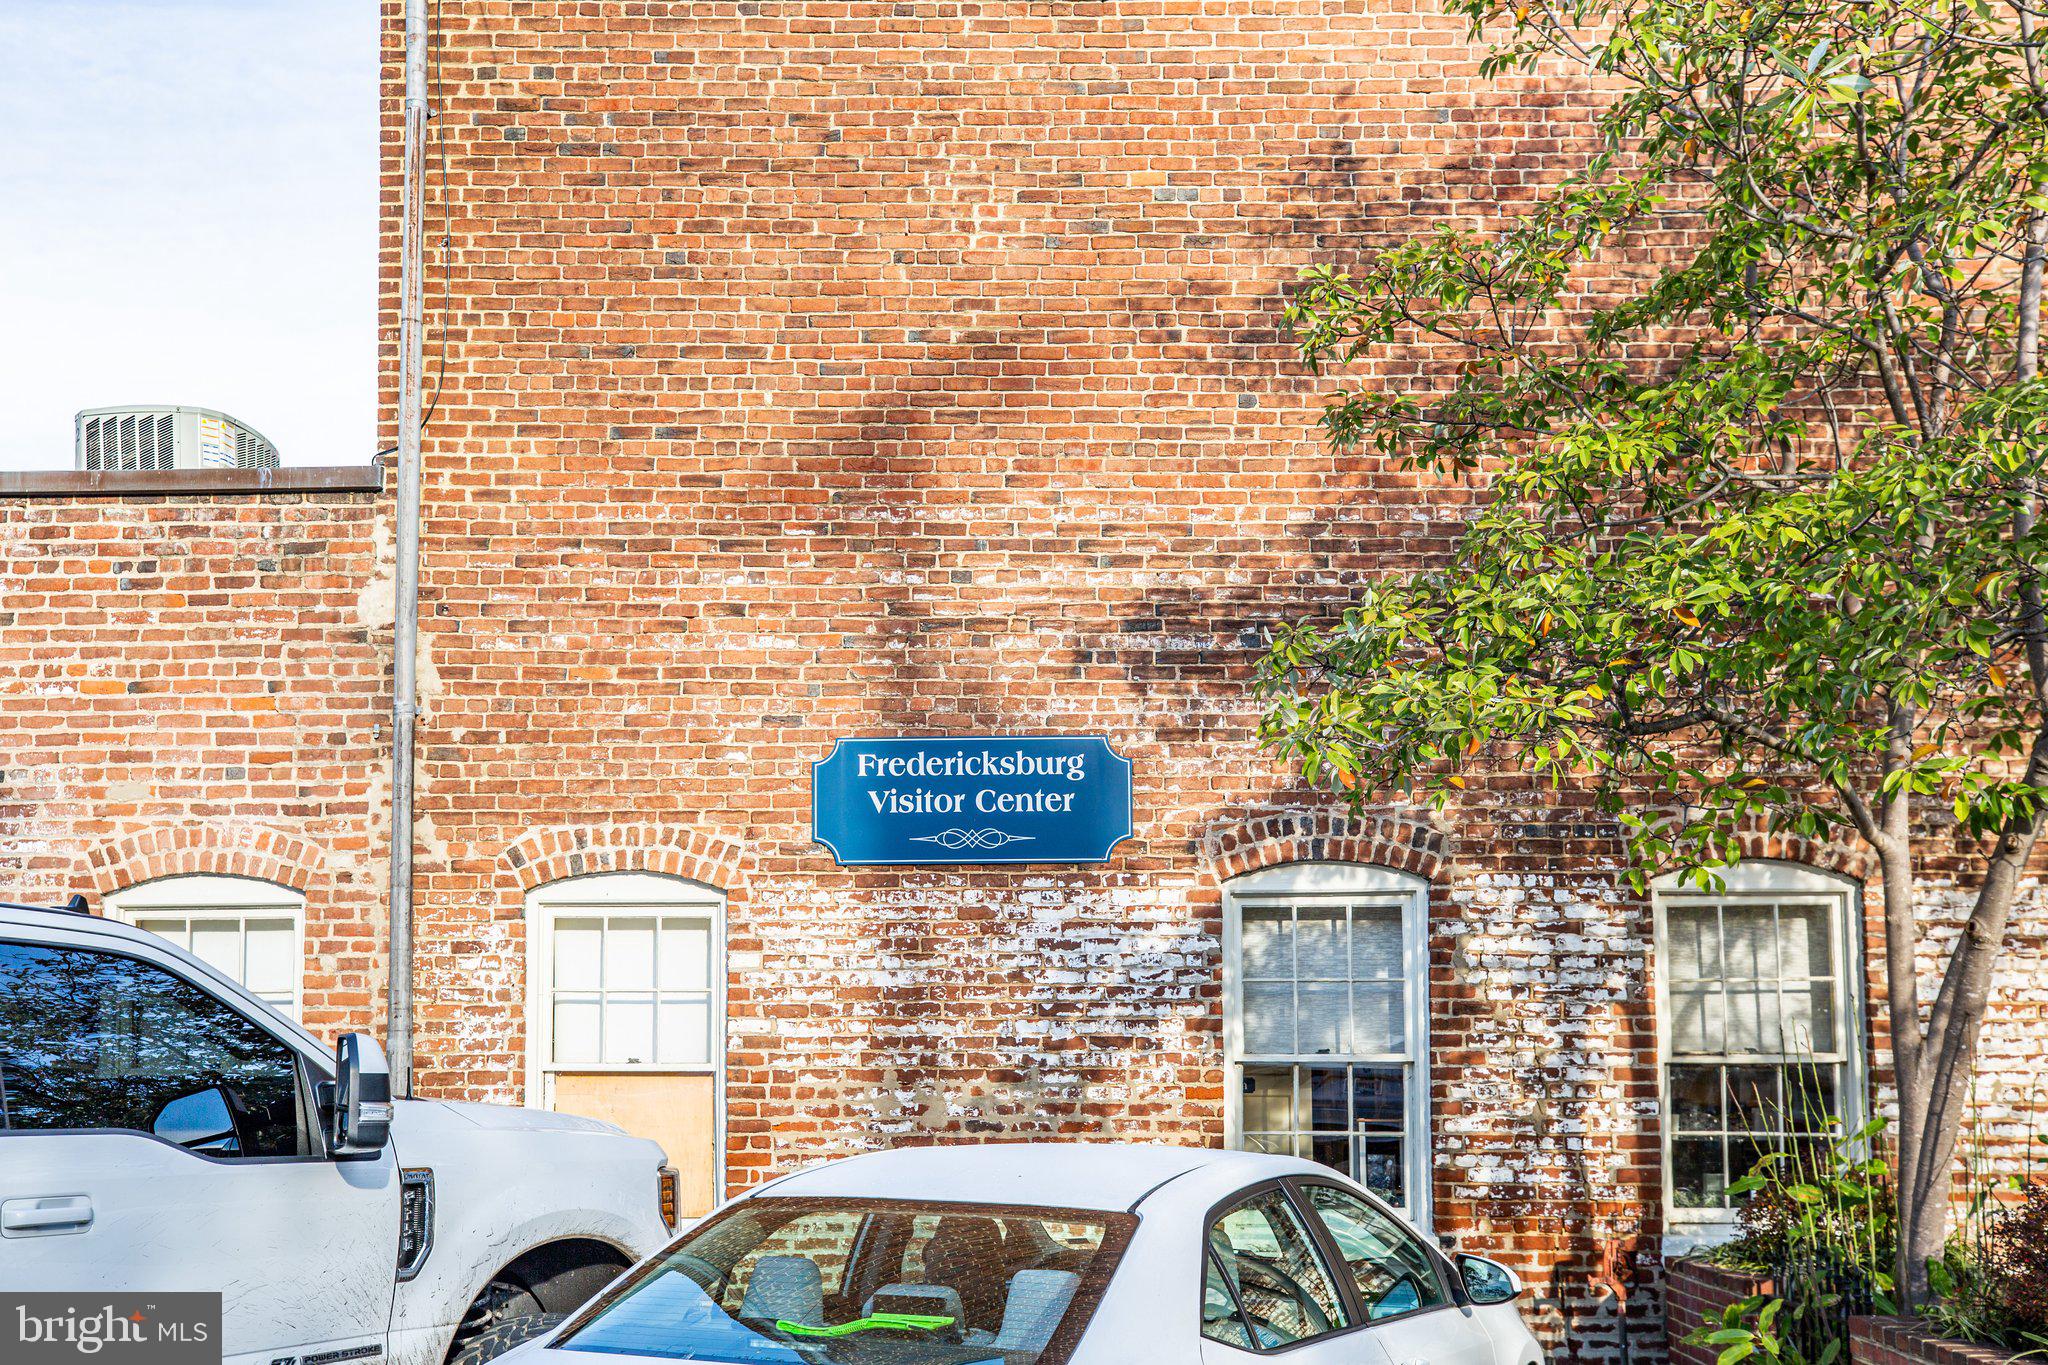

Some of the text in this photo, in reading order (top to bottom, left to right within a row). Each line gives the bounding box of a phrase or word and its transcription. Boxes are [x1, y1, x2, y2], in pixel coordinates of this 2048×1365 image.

[857, 751, 1085, 780] Fredericksburg
[867, 788, 1075, 813] Visitor Center
[305, 1351, 340, 1363] POWER
[341, 1344, 381, 1357] STROKE
